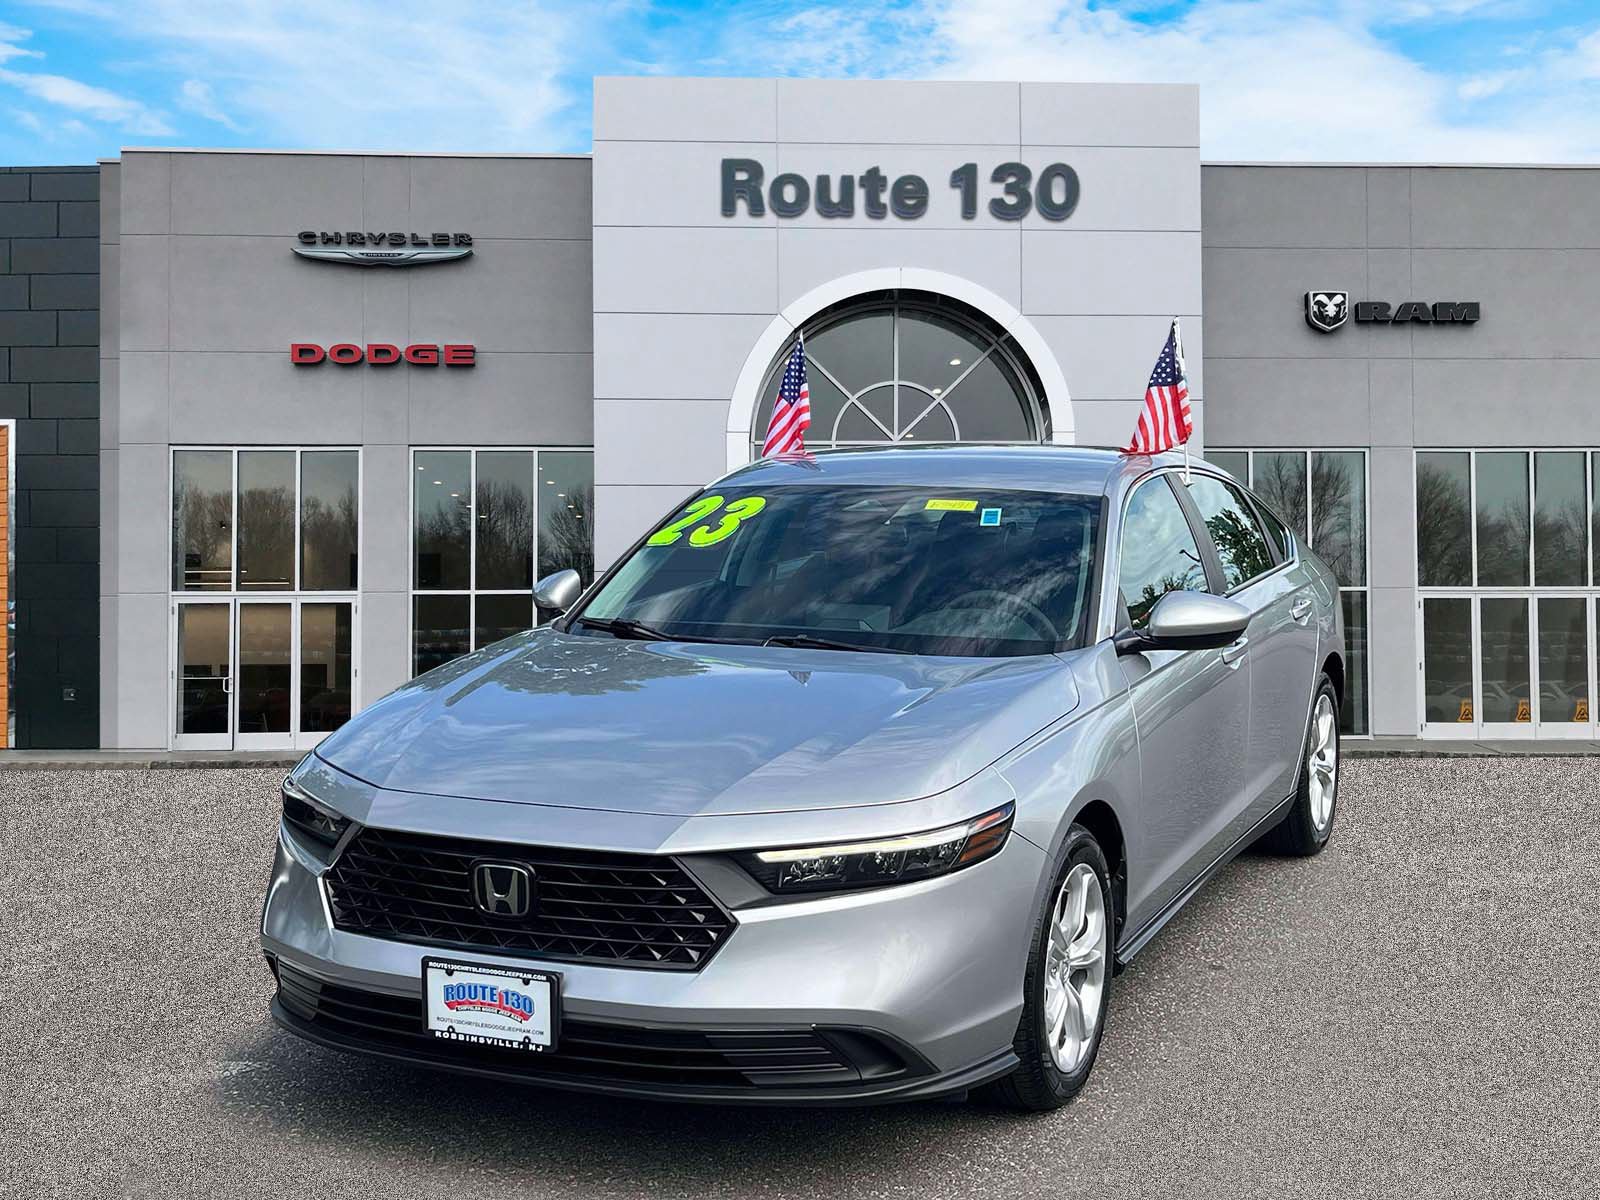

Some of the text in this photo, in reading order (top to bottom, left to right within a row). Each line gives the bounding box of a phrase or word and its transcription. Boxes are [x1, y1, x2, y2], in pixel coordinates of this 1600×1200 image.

[721, 158, 1080, 222] Route 130
[298, 231, 473, 246] CHRYSLER
[1355, 302, 1480, 325] RAM
[291, 343, 476, 366] DODGE
[646, 495, 767, 548] 23
[443, 982, 499, 1004] ROUTE
[499, 988, 535, 1016] 130
[528, 1042, 544, 1052] NJ
